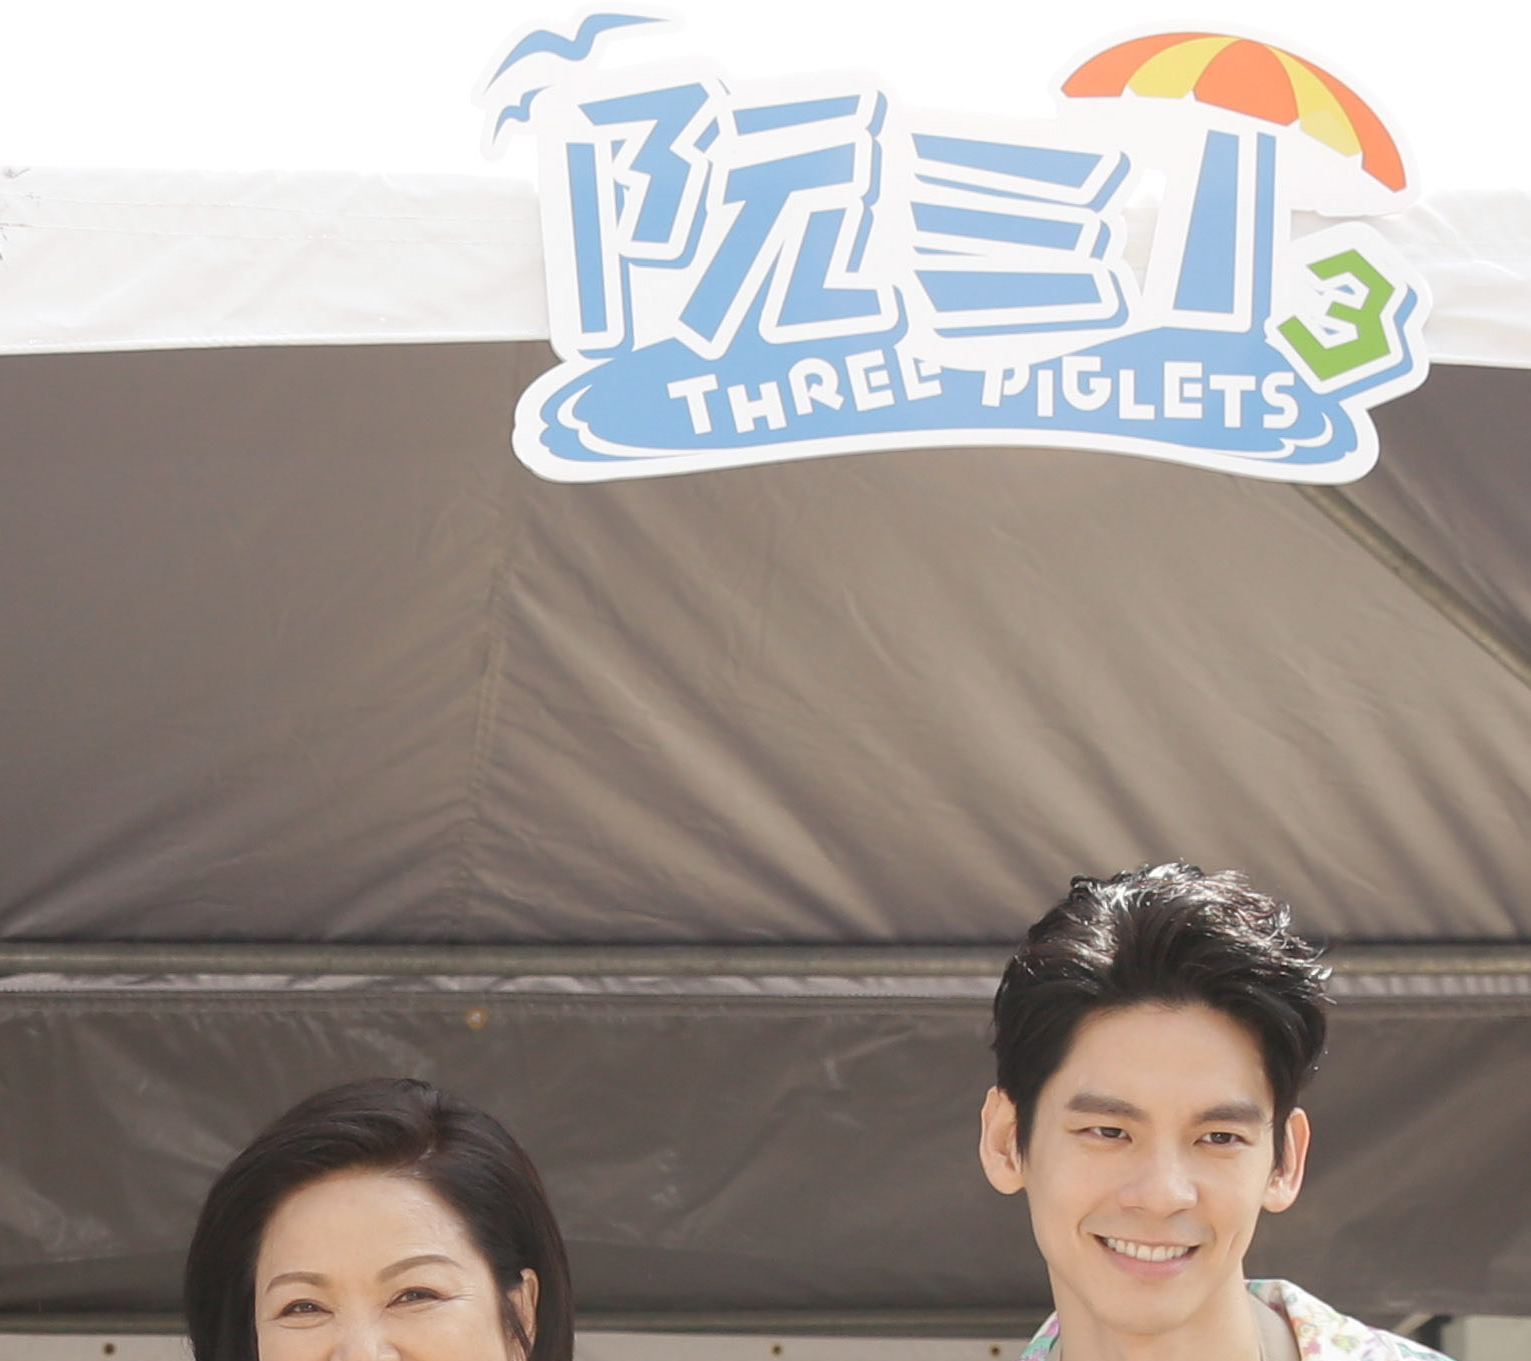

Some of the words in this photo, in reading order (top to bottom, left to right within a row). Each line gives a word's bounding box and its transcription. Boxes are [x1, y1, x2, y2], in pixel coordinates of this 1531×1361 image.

[1275, 248, 1395, 382] 3
[666, 348, 943, 435] THREE
[981, 356, 1299, 429] PIGLETS
